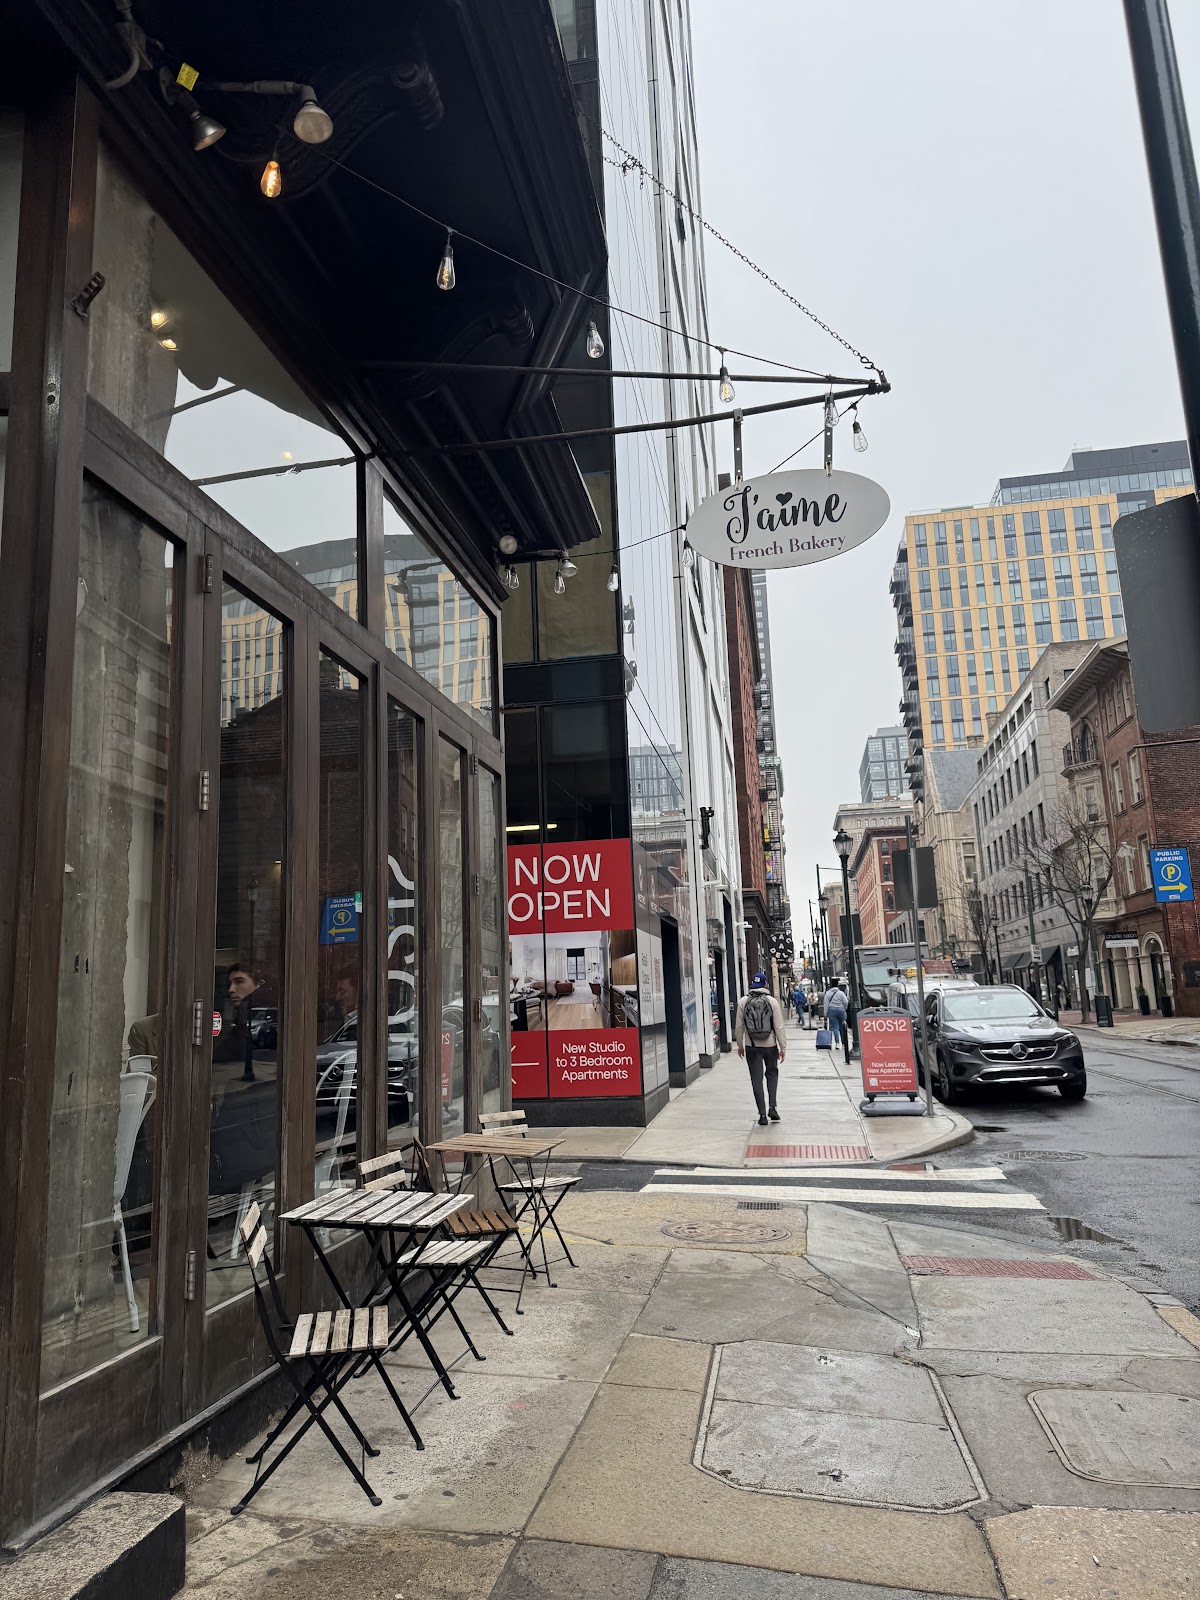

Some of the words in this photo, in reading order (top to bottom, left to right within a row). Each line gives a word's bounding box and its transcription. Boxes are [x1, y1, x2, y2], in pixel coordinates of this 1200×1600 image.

[730, 541, 784, 561] French
[789, 535, 846, 556] Bakery
[515, 853, 601, 886] NOW
[507, 888, 611, 922] OPEN
[562, 1042, 586, 1054] New
[589, 1041, 626, 1053] Studio
[555, 1056, 567, 1067] to
[569, 1056, 577, 1067] 3
[579, 1053, 633, 1066] Bedroom
[884, 1061, 907, 1069] Leasing
[561, 1068, 628, 1084] Apartments
[880, 1067, 912, 1075] Apartments
